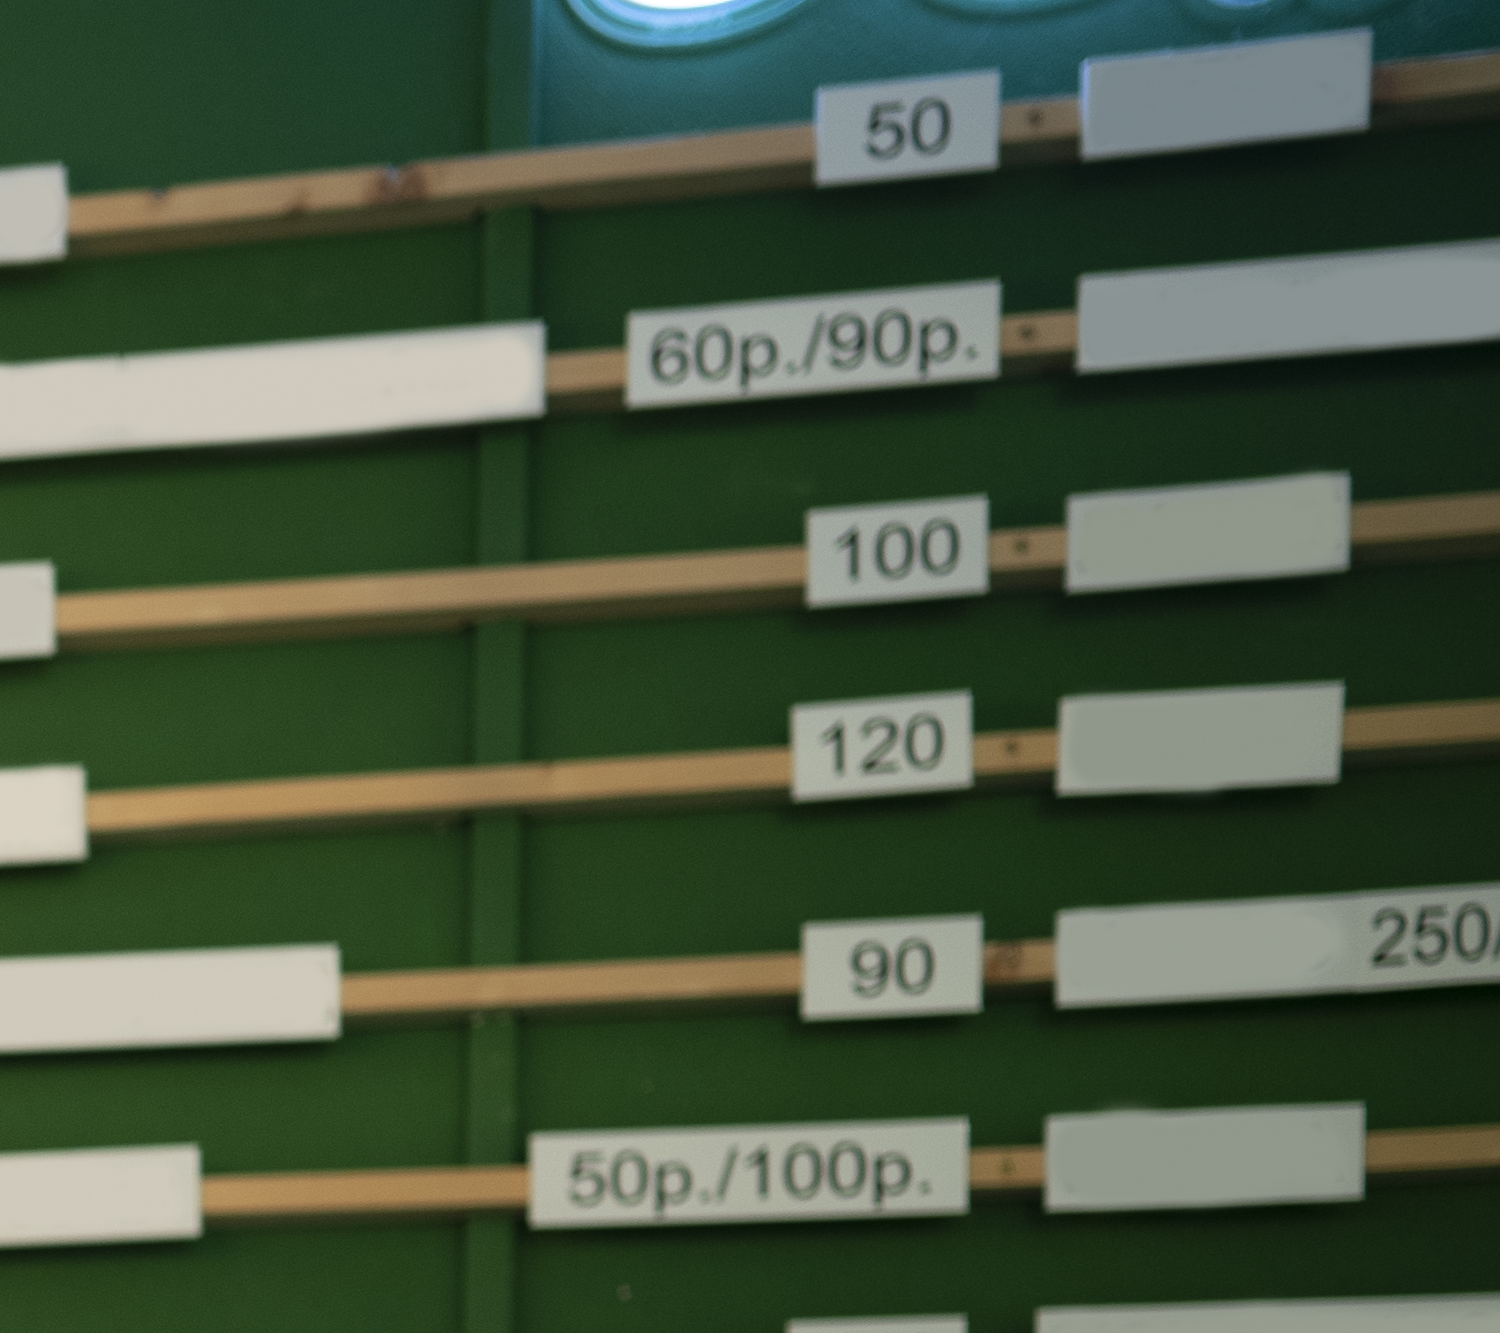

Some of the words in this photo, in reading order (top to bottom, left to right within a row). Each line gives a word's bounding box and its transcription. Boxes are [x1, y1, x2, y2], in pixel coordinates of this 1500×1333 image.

[866, 97, 952, 160] 50
[835, 518, 962, 582] 100
[821, 713, 946, 776] 120
[850, 938, 936, 998] 90
